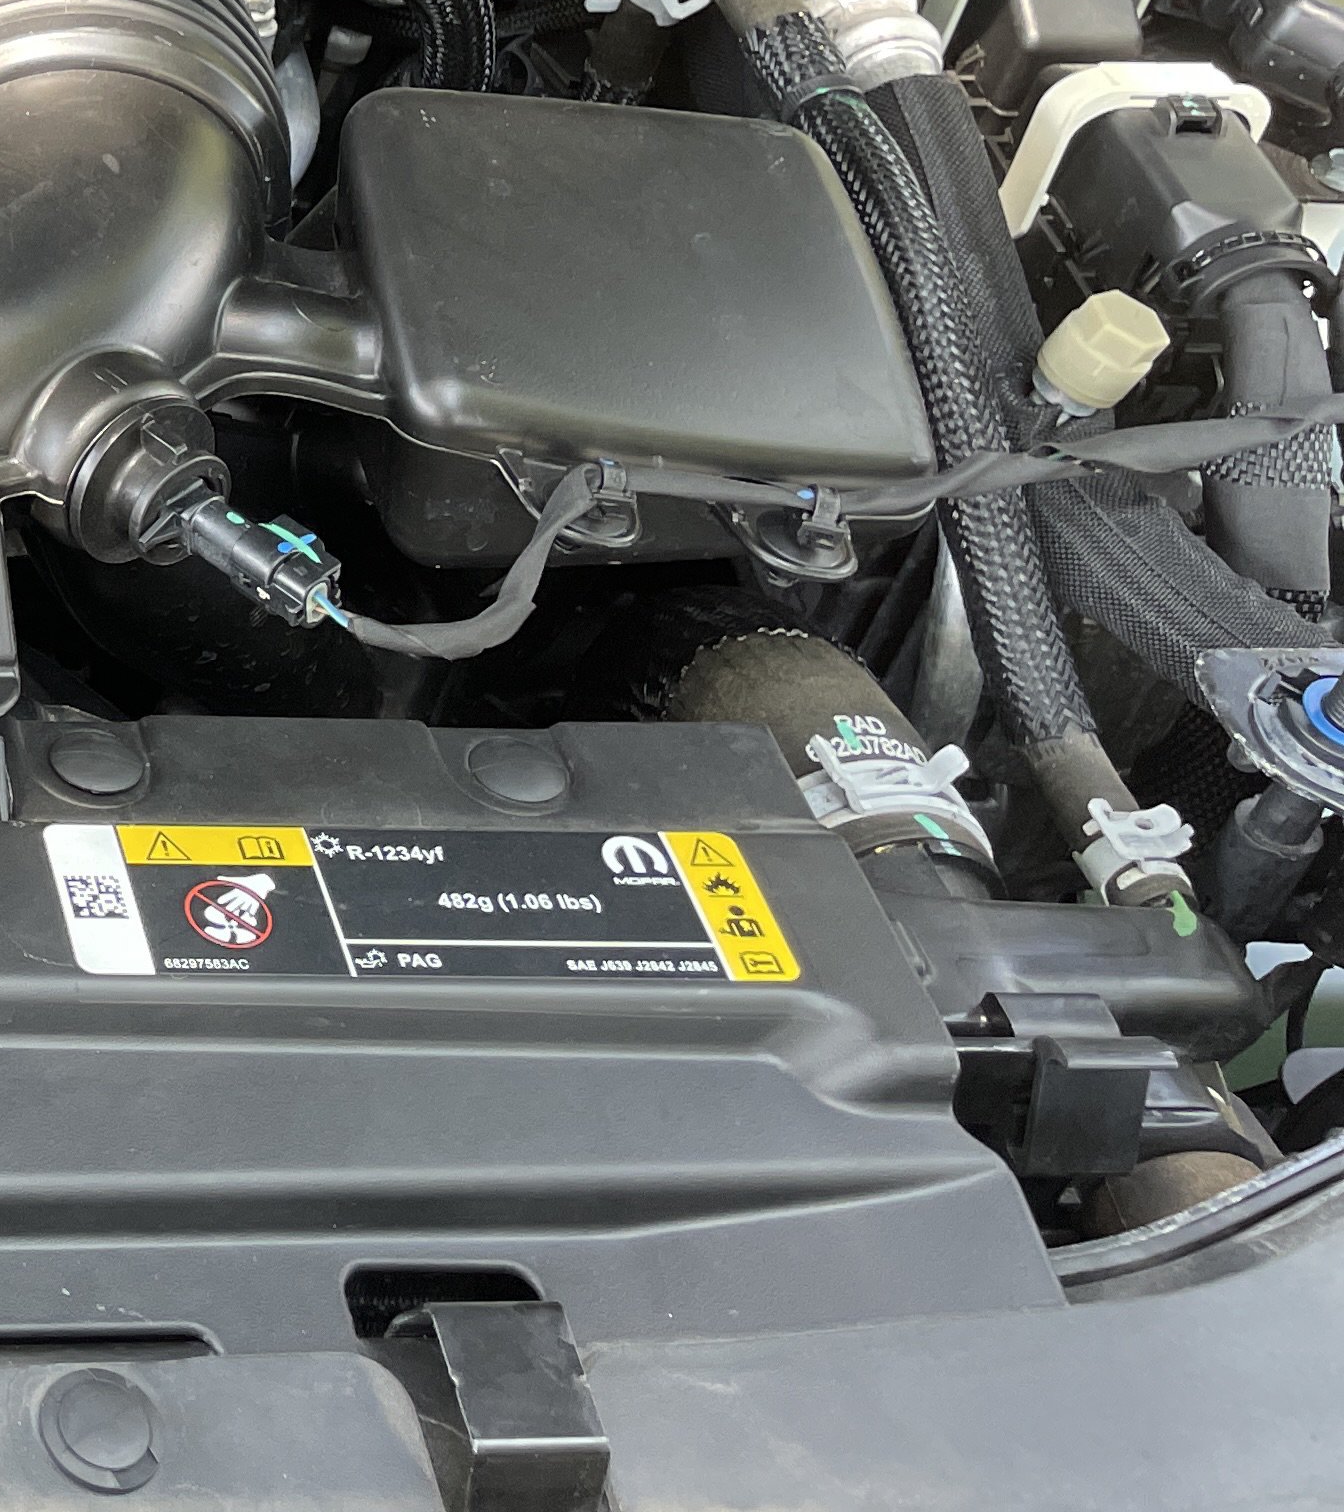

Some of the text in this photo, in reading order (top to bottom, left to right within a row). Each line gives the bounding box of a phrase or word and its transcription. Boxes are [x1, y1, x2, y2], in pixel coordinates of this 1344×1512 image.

[345, 844, 445, 862] R-1234yf
[612, 876, 676, 887] MOPAR
[438, 892, 603, 914] 482g (1.06 lbs)
[396, 953, 443, 969] PAG
[565, 959, 598, 972] SAE
